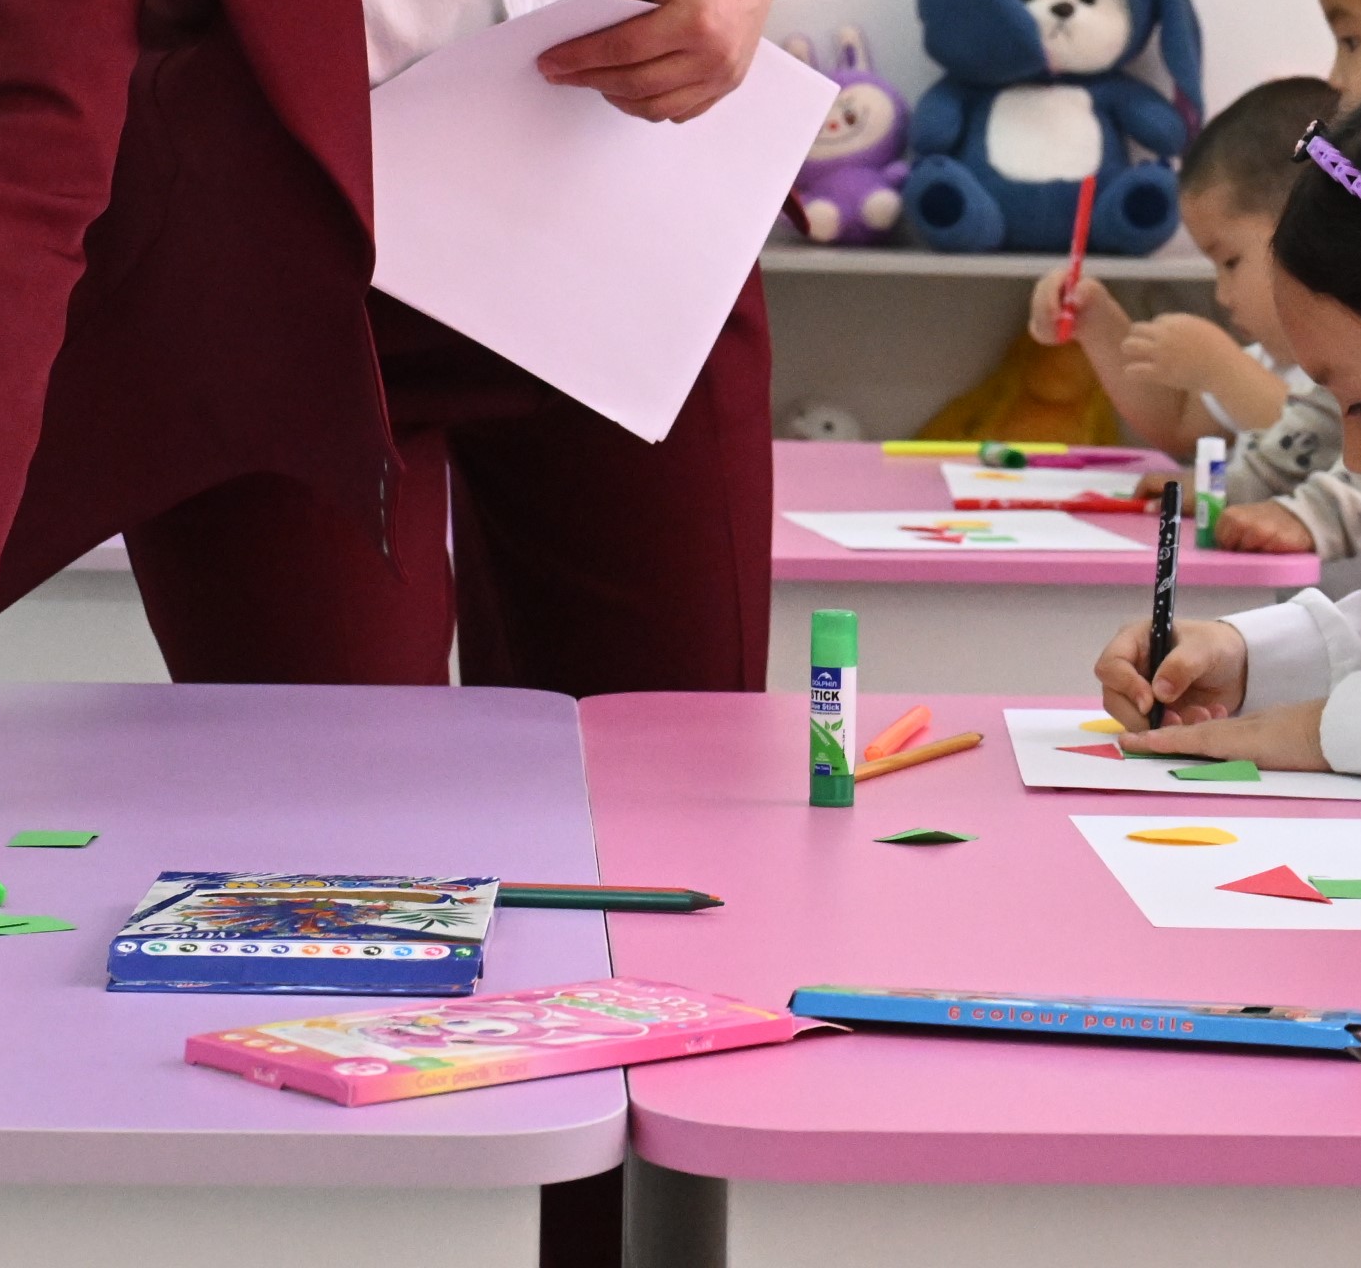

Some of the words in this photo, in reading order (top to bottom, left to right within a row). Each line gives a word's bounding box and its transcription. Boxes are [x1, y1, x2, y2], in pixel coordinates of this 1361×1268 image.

[822, 703, 840, 711] Stick
[948, 1006, 961, 1020] 6
[972, 1007, 1069, 1024] colour
[1083, 1013, 1195, 1032] pencils
